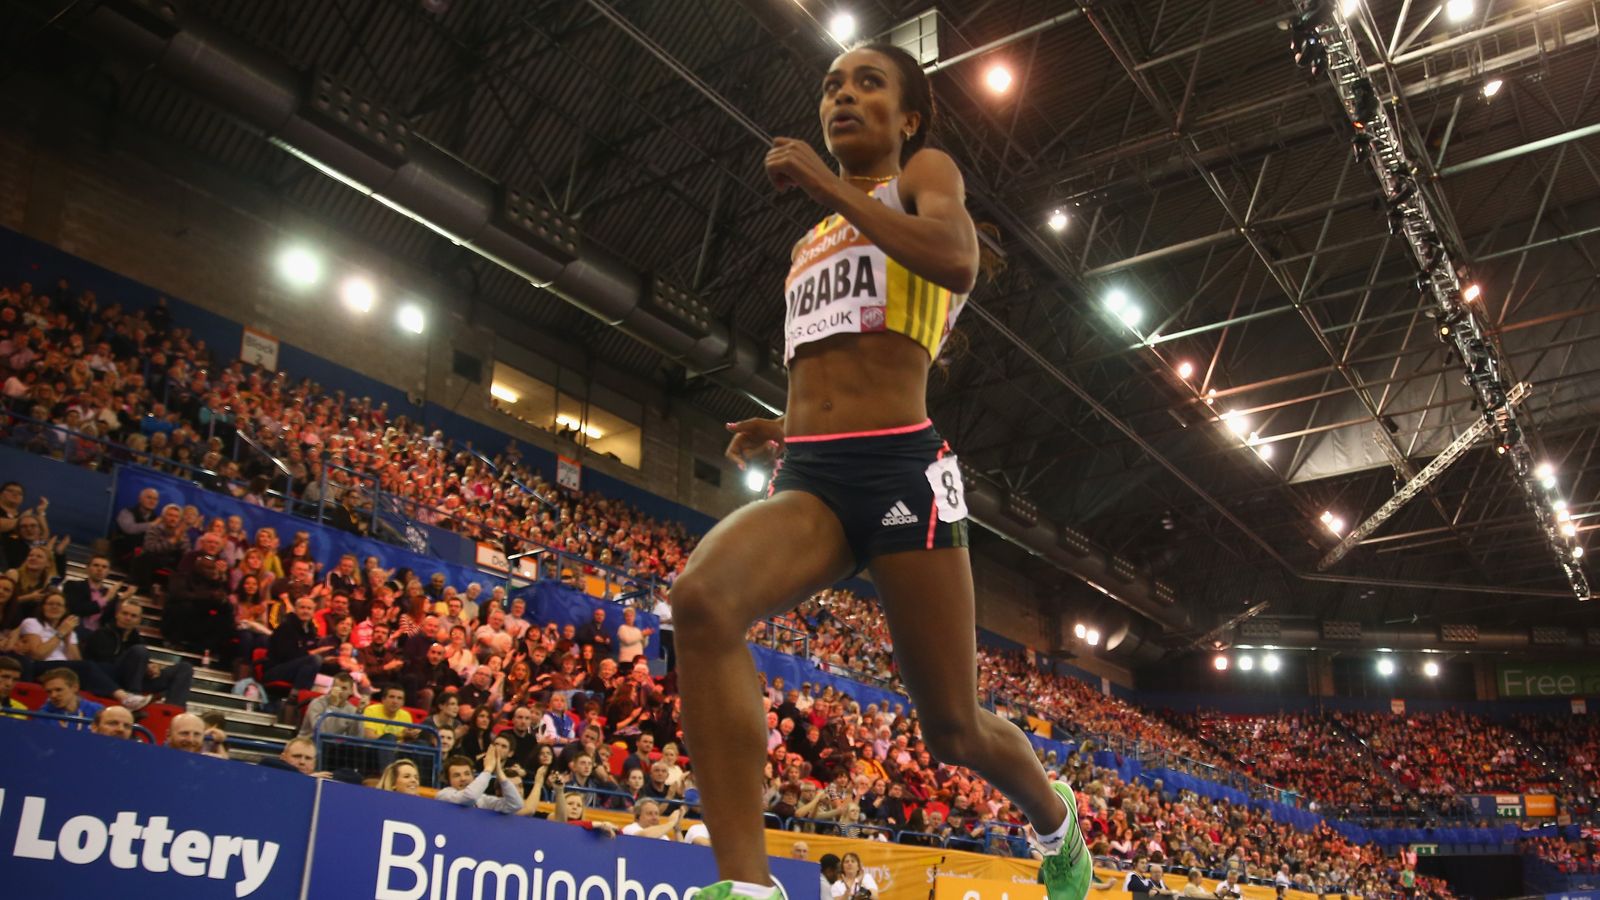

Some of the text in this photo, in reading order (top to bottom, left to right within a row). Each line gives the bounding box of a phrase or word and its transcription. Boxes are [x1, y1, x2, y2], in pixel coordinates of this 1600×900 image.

[789, 311, 853, 340] G.CO.UK
[942, 471, 958, 508] 8
[882, 515, 918, 526] adidas
[1504, 670, 1575, 696] Free
[13, 796, 280, 898] Lottery
[375, 819, 704, 900] Birminh
